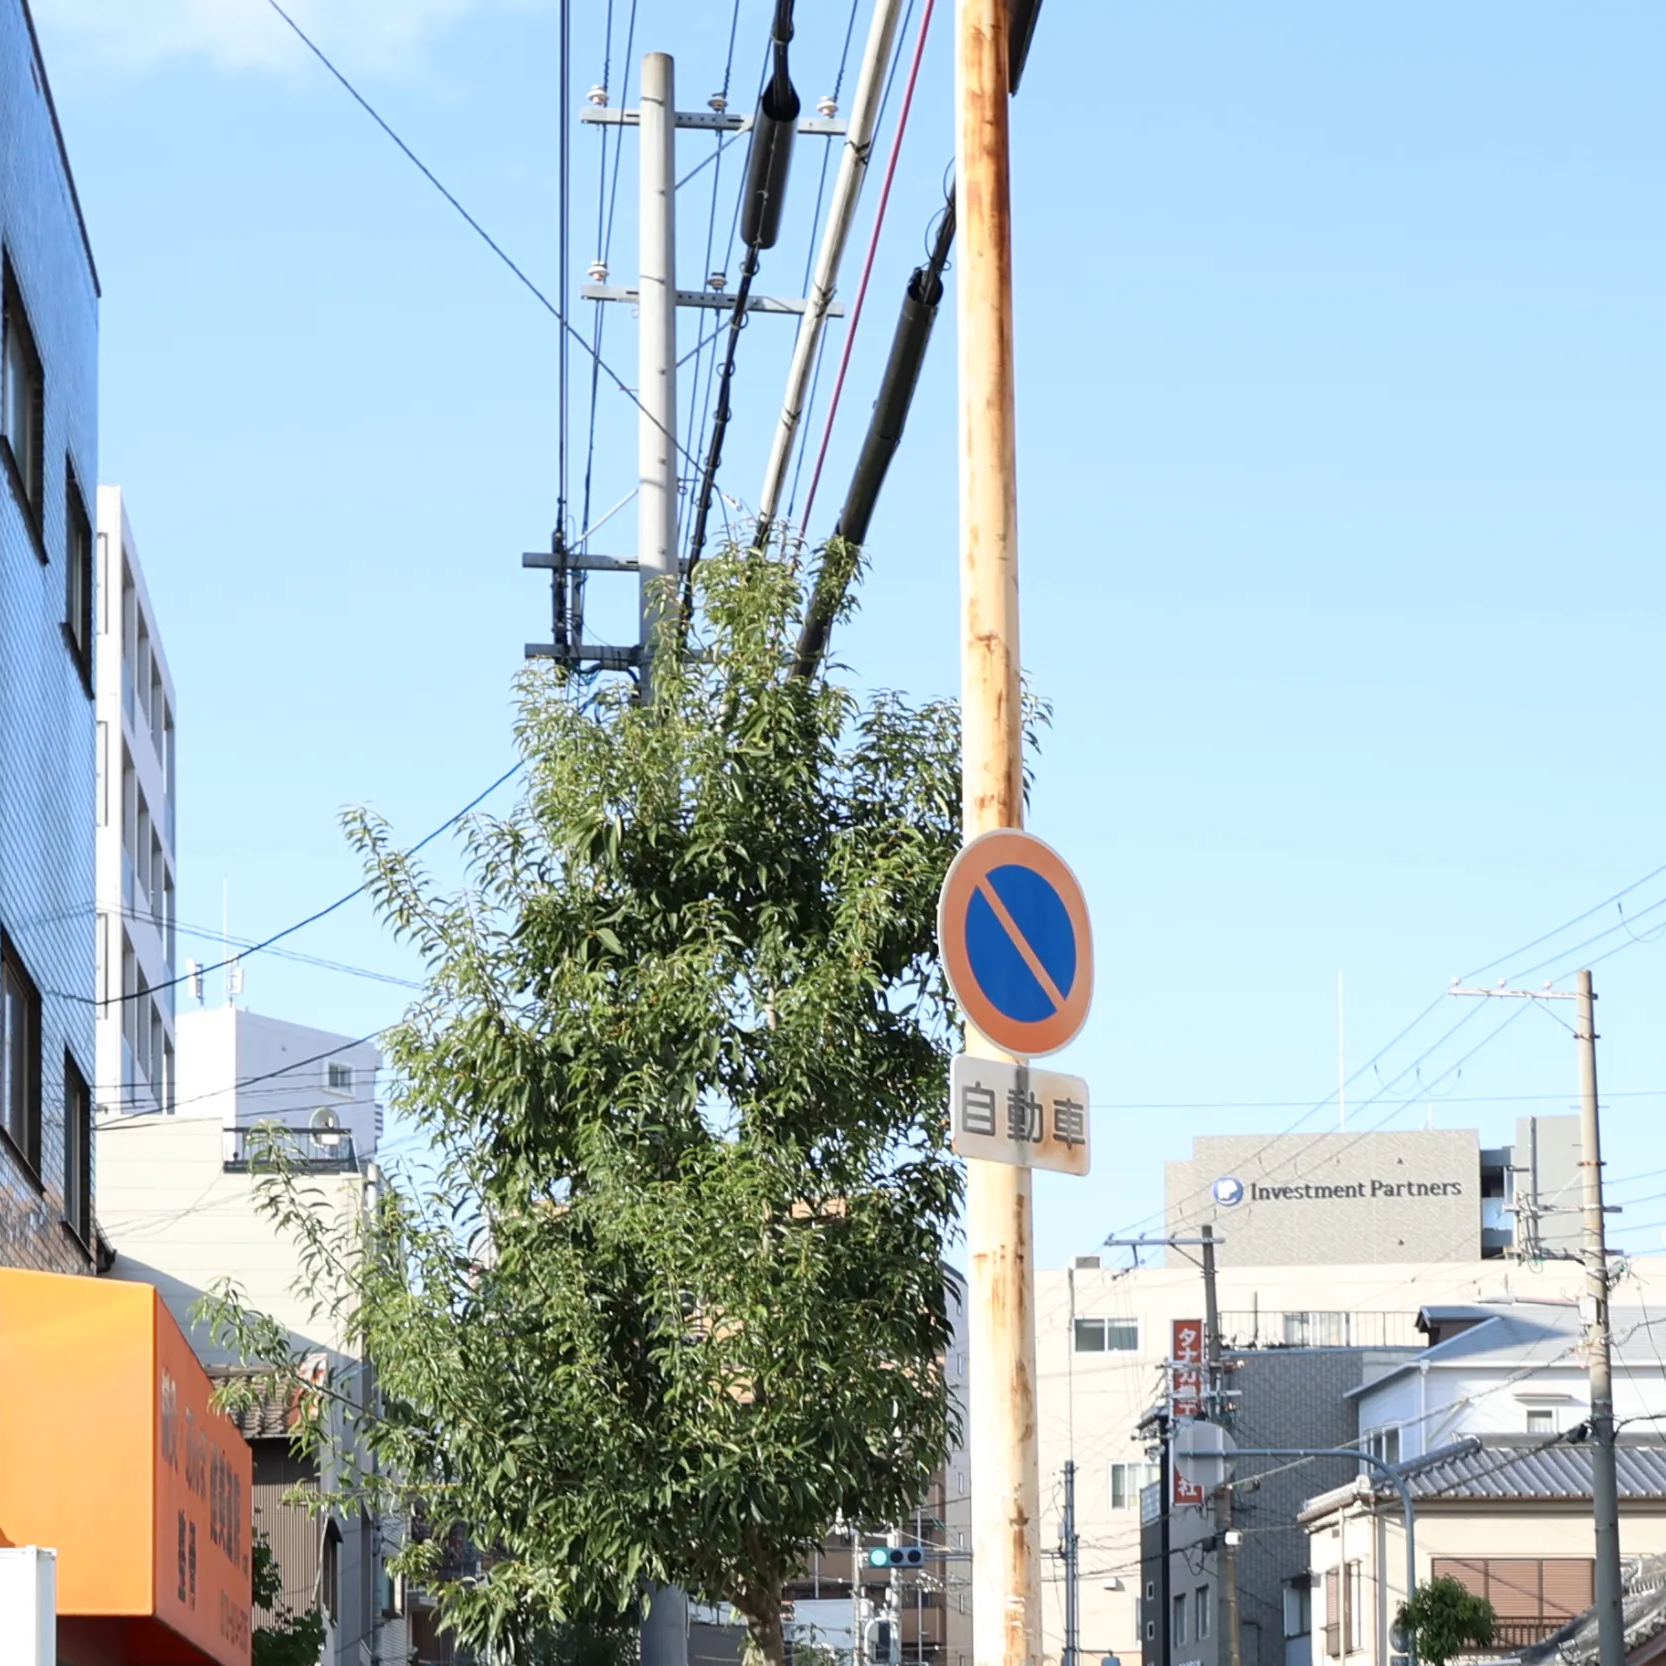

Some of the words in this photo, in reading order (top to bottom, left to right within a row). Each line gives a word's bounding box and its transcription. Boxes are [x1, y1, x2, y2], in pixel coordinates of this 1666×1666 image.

[961, 1081, 1086, 1152] 自動車
[1251, 1182, 1366, 1200] Investment
[1370, 1179, 1462, 1198] Partners
